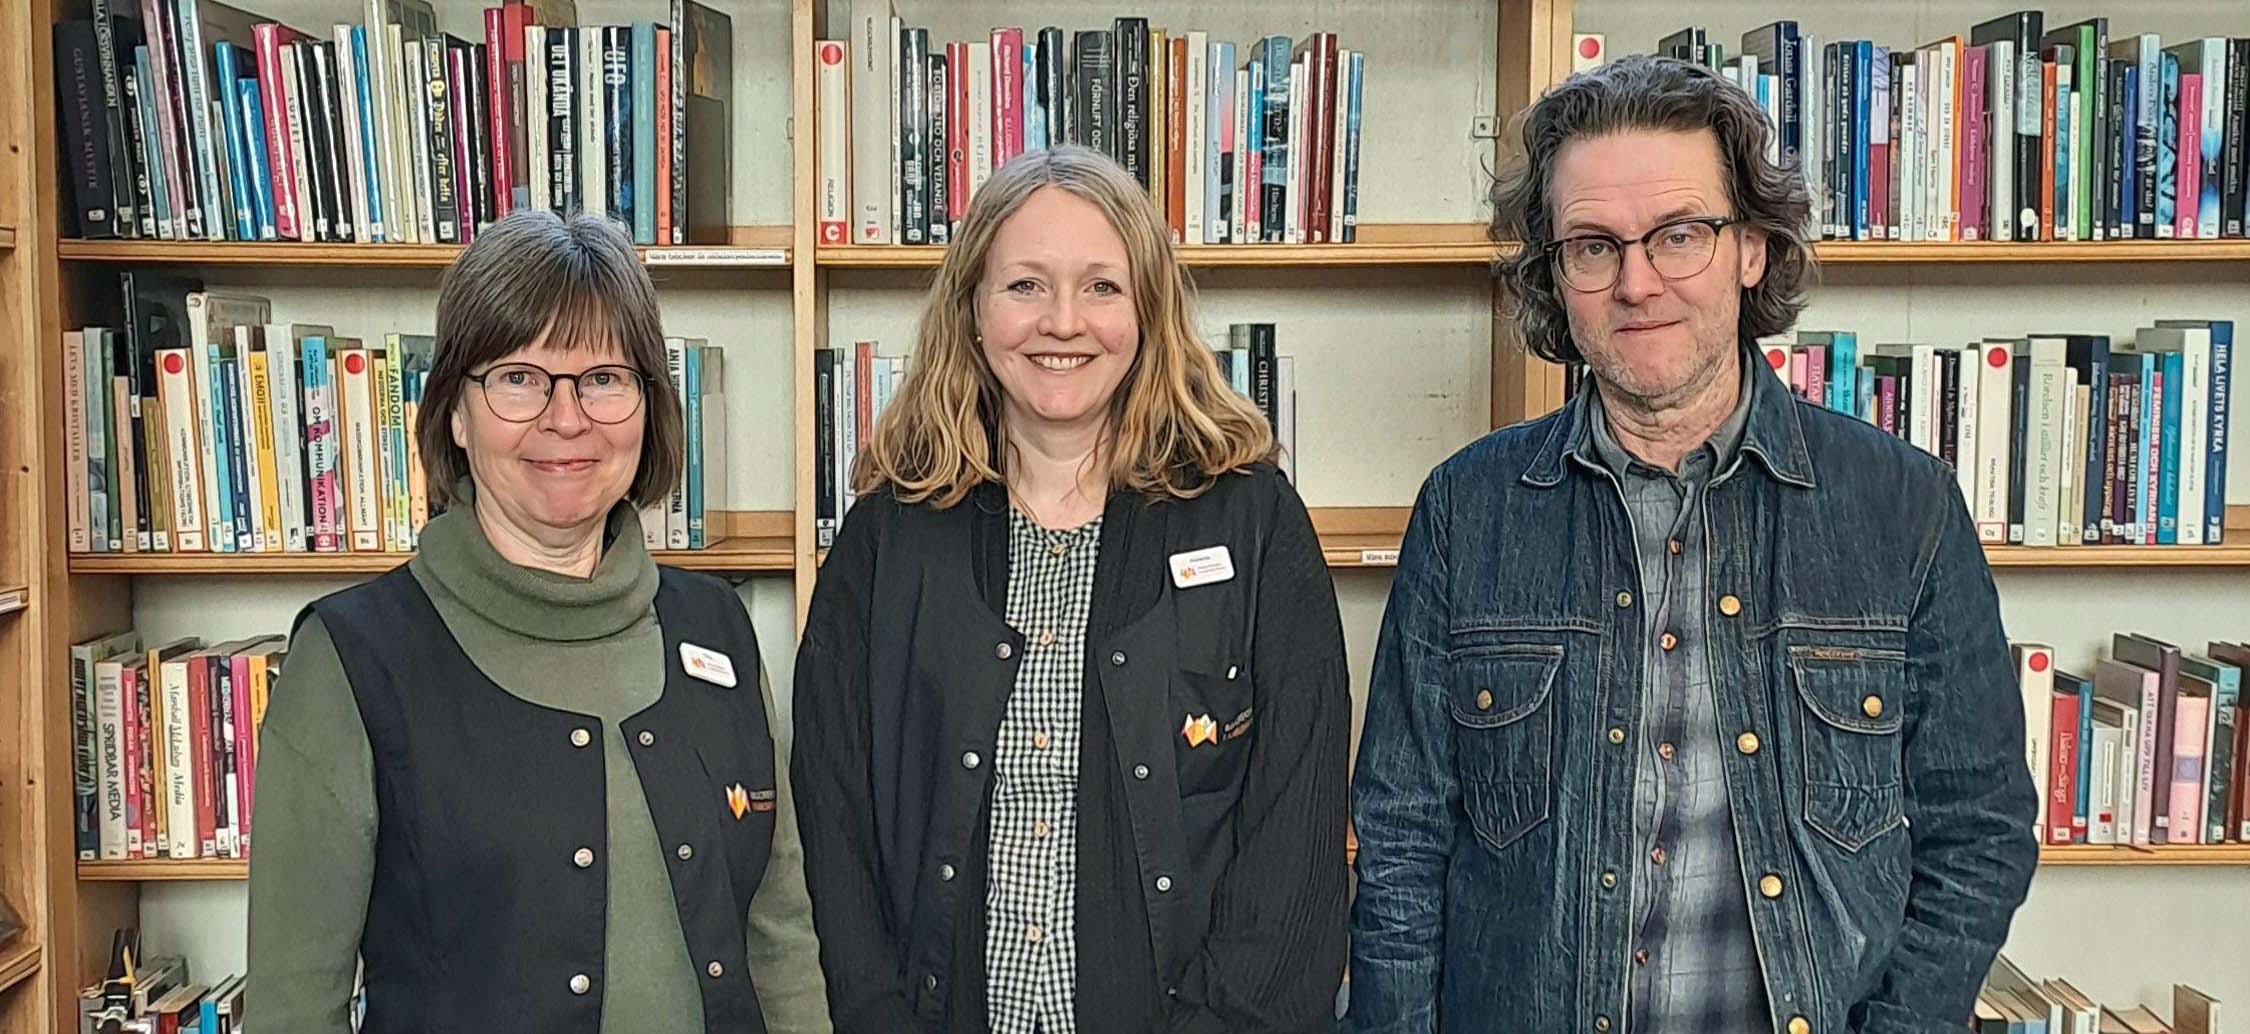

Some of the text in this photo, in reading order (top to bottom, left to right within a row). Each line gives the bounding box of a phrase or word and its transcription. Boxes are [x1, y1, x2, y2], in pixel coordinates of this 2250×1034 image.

[603, 49, 627, 85] UFO
[1783, 39, 1797, 74] Jonas
[1089, 79, 1103, 126] FÖRNUFT
[1126, 76, 1139, 102] Den
[1784, 77, 1797, 124] Gardell
[932, 69, 943, 211] BORTOM TRO OCH VETANDE
[1123, 104, 1139, 151] religiösa
[669, 349, 681, 372] ANJA
[68, 345, 82, 462] LEVA MED KRISTALLER
[254, 374, 266, 404] EMOJI
[389, 368, 402, 425] FANDOM
[2040, 372, 2053, 419] Rörelsen
[2212, 344, 2228, 452] HELA LIVETS KYRKA
[312, 406, 322, 425] OM
[312, 427, 328, 524] KOMMUNIKATION
[2039, 463, 2050, 483] och
[2147, 386, 2162, 522] FEMINISM OCH KYRKAN
[168, 683, 183, 724] Marshall
[102, 723, 118, 779] SPRIDBAR
[108, 781, 121, 822] MEDIA
[173, 773, 185, 806] Media
